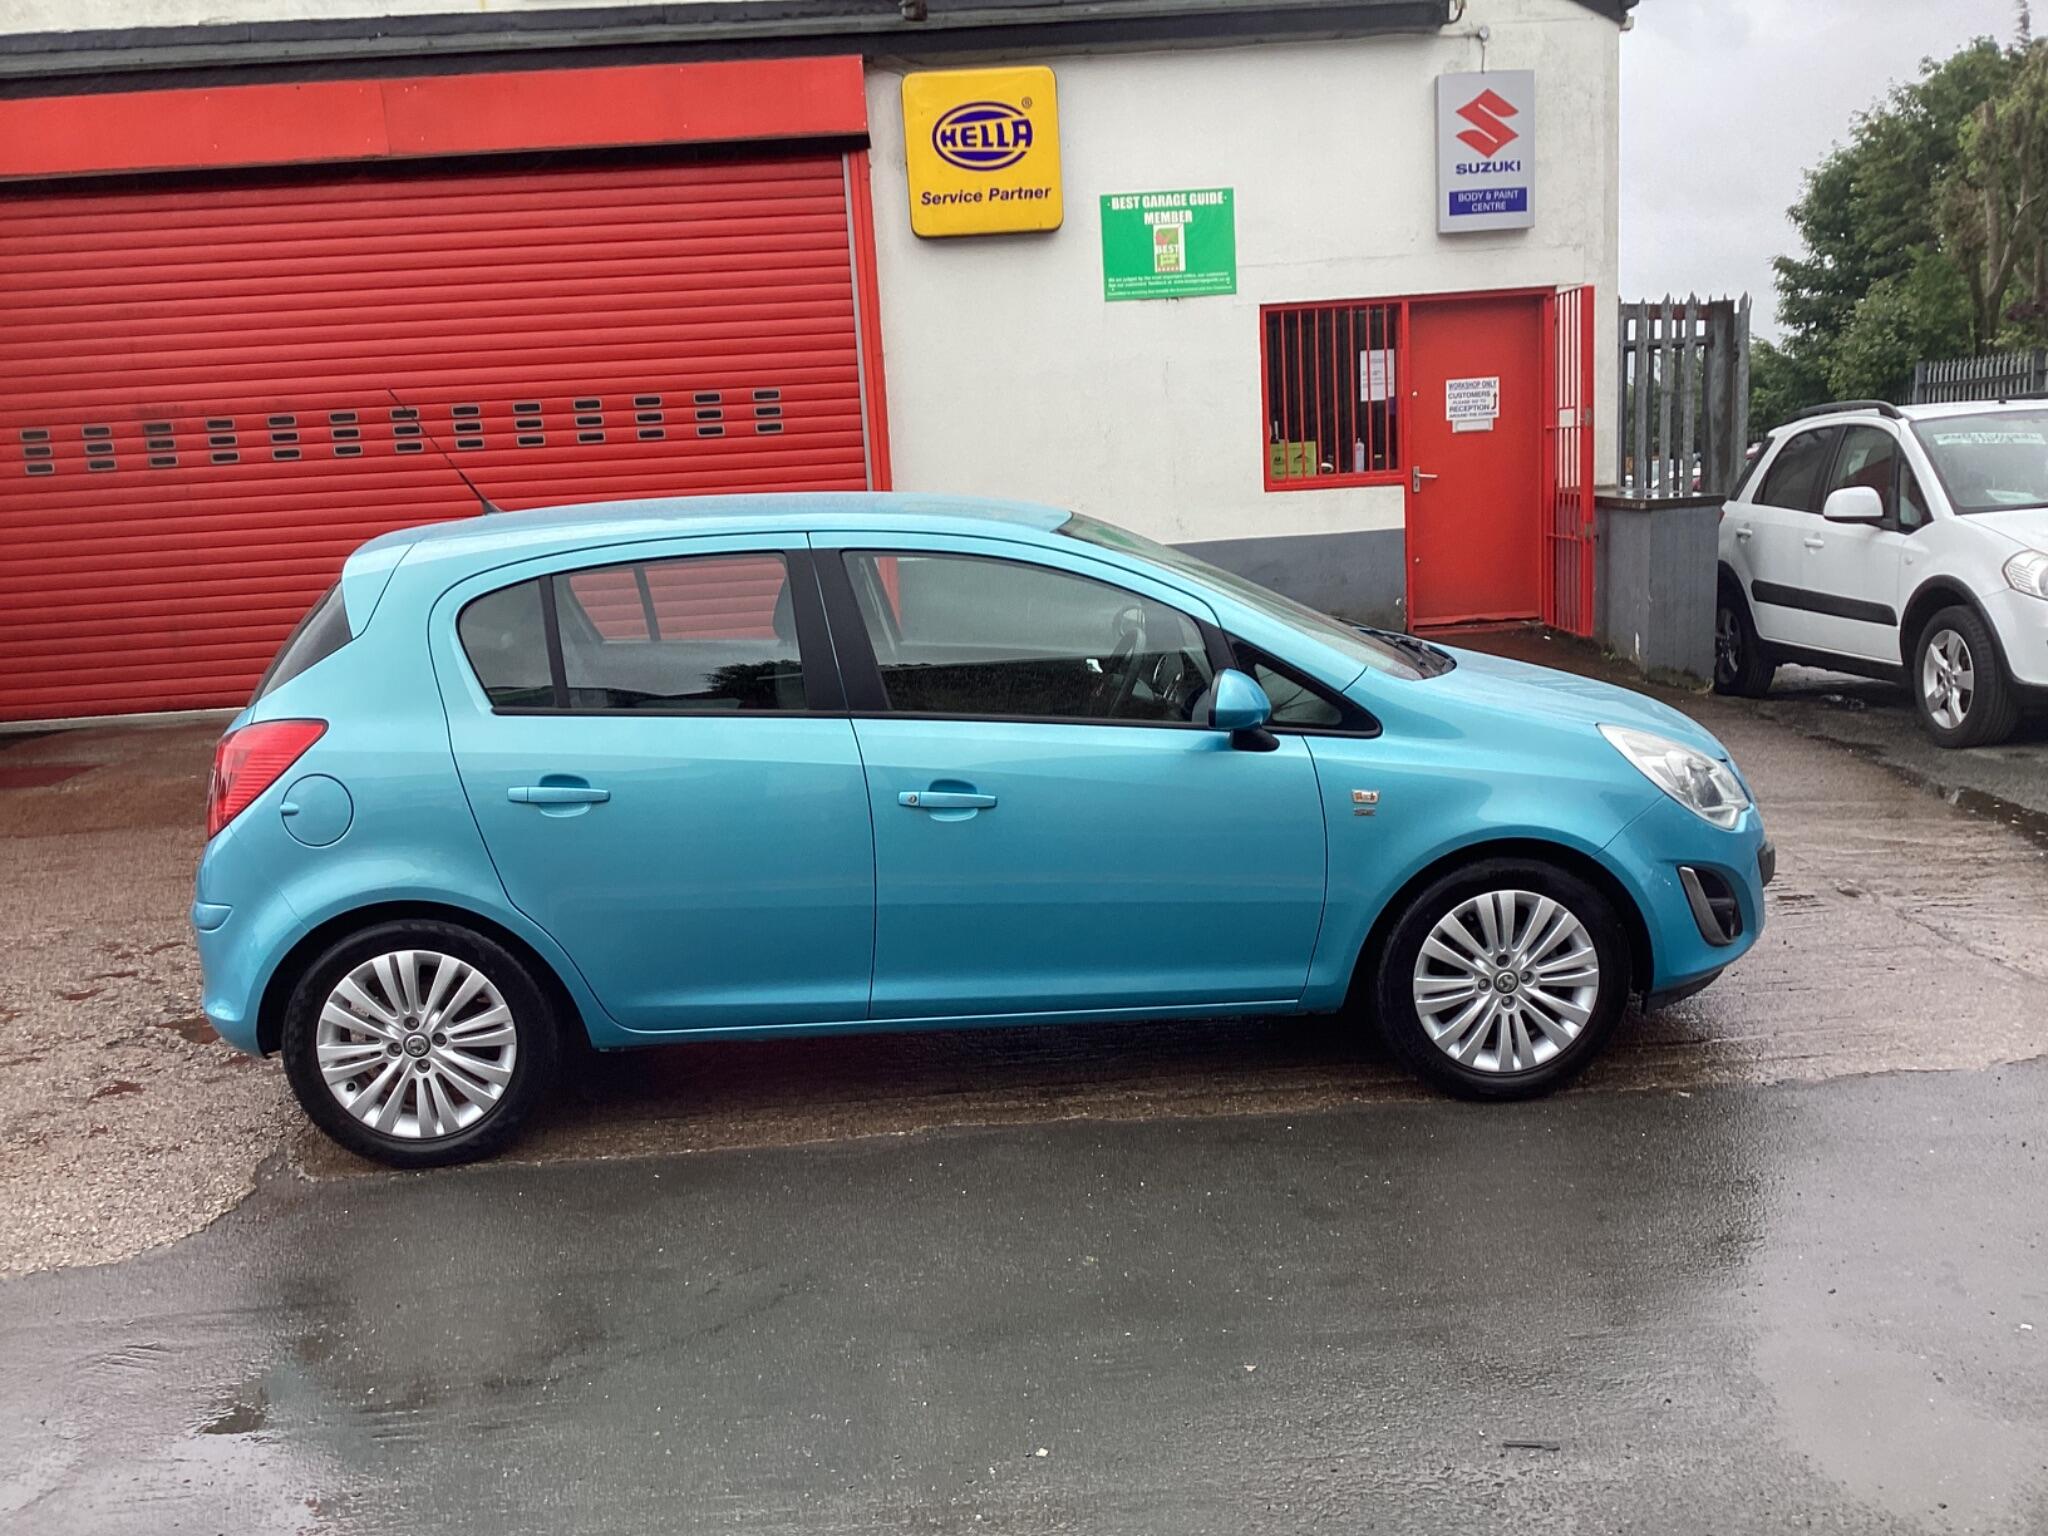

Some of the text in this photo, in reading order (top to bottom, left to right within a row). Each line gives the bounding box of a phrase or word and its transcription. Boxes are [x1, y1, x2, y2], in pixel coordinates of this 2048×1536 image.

[940, 119, 1033, 148] HELLA
[1456, 160, 1521, 175] SUZUKI
[921, 187, 1052, 206] Service Partner
[1112, 191, 1223, 210] BEST GARAGE GUIDE
[1457, 190, 1519, 202] BODY & PAINT
[1471, 201, 1506, 212] CENTRE
[1144, 210, 1193, 225] MEMBER
[1449, 404, 1490, 412] RECEPTION
